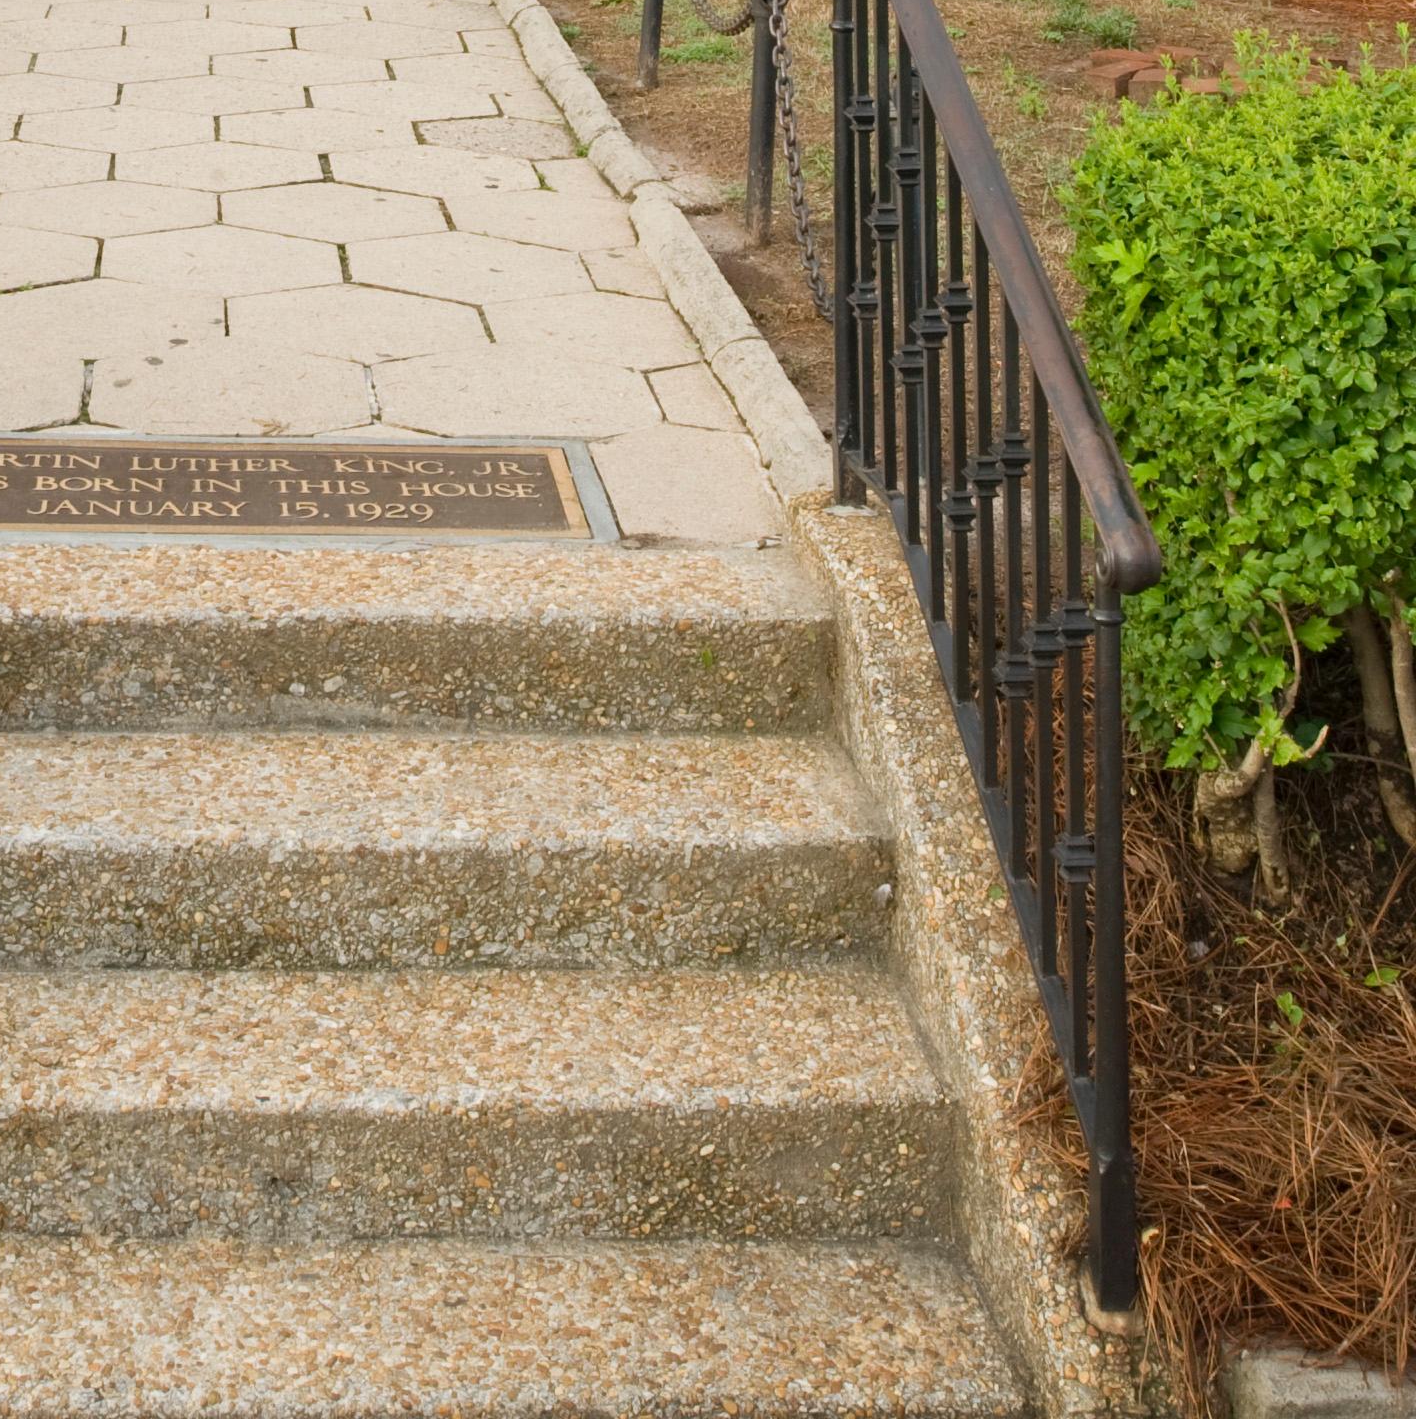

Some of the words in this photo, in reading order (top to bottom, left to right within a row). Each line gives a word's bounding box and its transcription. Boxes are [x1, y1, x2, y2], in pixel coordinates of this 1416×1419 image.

[129, 456, 303, 471] LUTHER
[472, 461, 543, 476] JR.
[34, 475, 165, 493] BORN
[191, 478, 242, 494] IN
[270, 479, 371, 495] THIS
[400, 481, 541, 498] HOUSE
[26, 499, 248, 517] JANUARY
[348, 502, 435, 523] 1929
